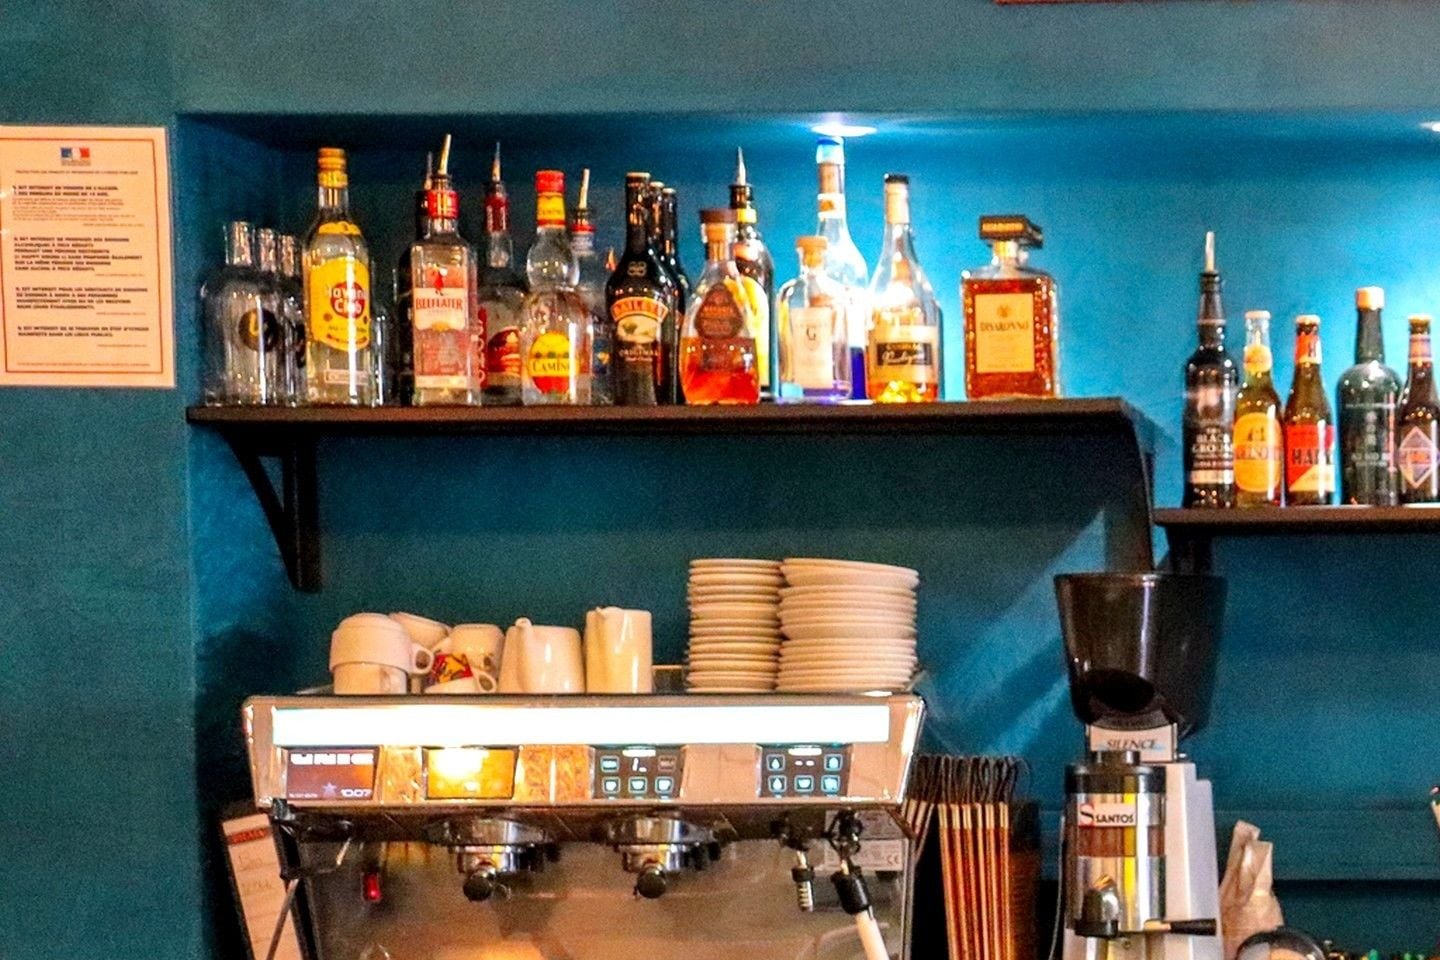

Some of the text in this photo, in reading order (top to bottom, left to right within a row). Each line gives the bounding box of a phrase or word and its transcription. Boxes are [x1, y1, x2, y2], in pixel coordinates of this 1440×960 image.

[415, 298, 463, 310] BEEFEATER
[532, 359, 573, 373] CAMIN
[1106, 739, 1156, 751] SILENCE
[1095, 814, 1134, 824] SANTOS
